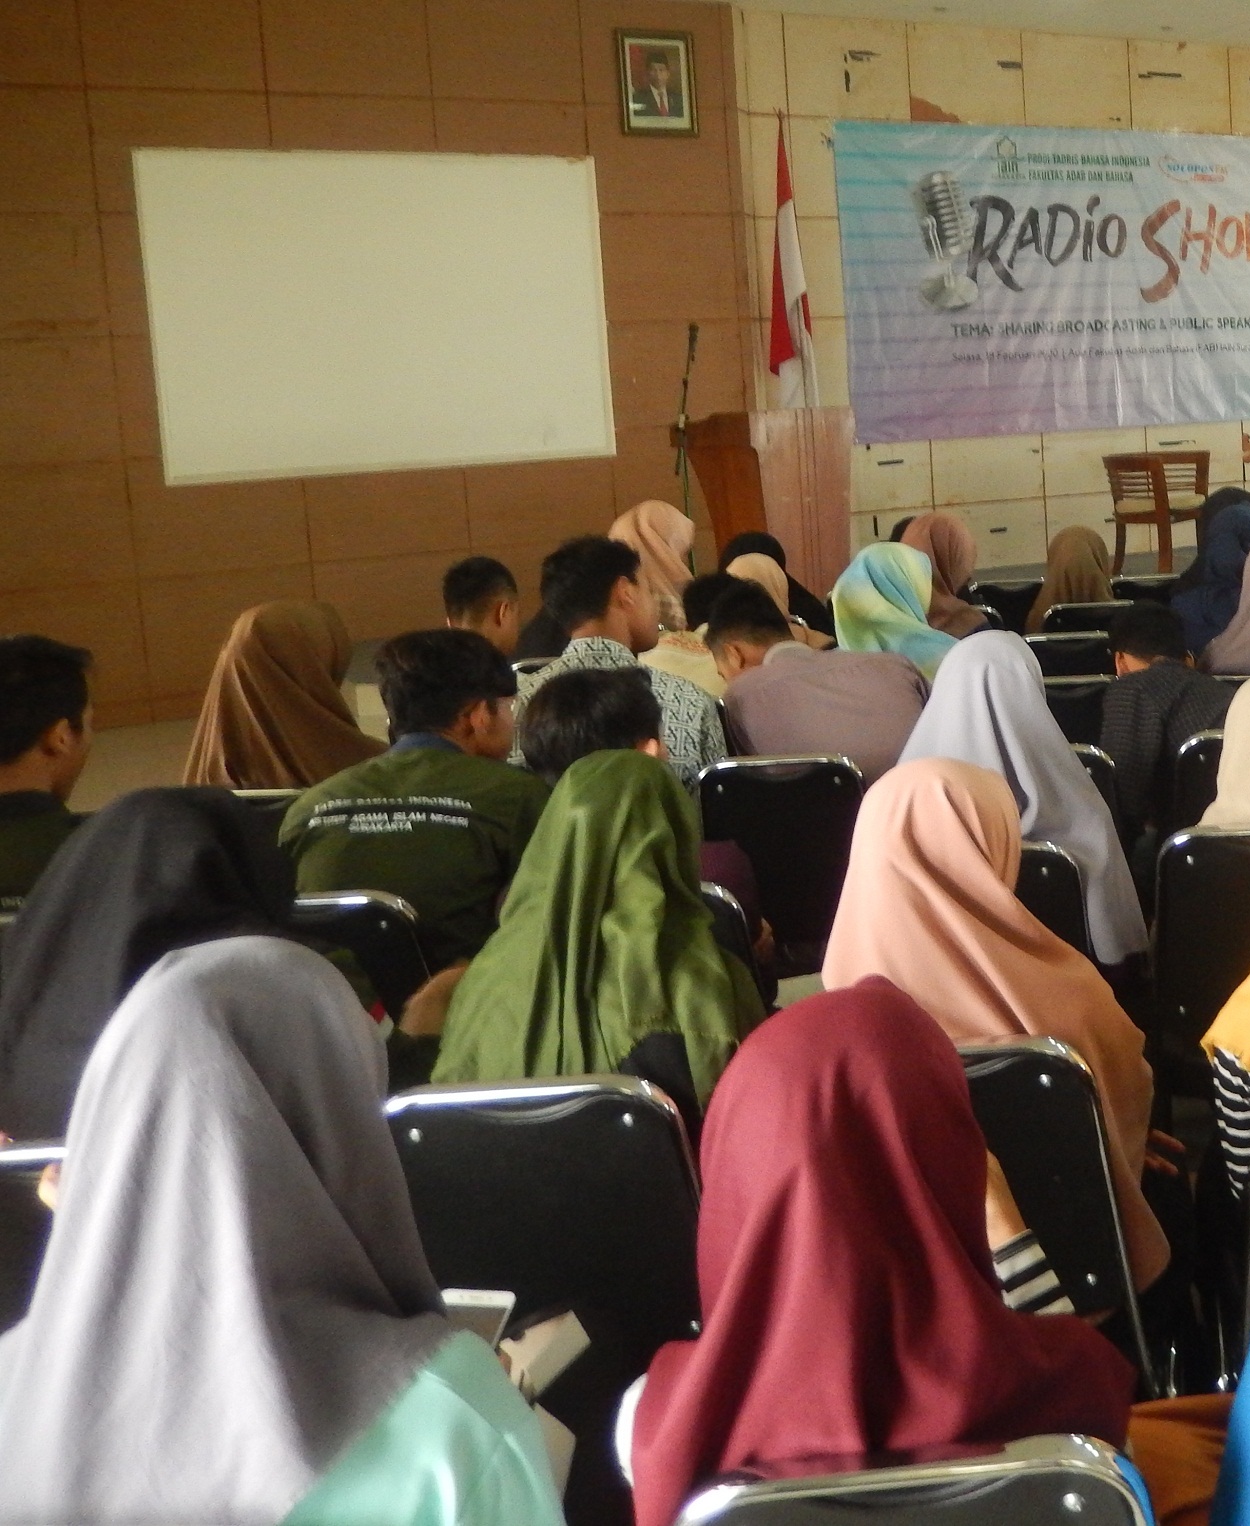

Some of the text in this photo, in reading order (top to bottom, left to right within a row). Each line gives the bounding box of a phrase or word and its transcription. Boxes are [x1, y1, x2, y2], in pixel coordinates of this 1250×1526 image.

[1052, 153, 1079, 166] TADRIS
[1081, 154, 1110, 167] BAHASA
[1111, 154, 1151, 168] INDONESIA
[1028, 169, 1065, 181] FAKULTAS
[1066, 170, 1086, 181] ADAB
[1088, 170, 1103, 182] DAN
[1105, 171, 1134, 183] BAHASA
[1057, 317, 1156, 334] BROADCASTING
[1170, 316, 1214, 330] PUBLIC
[408, 795, 473, 811] INDONESIA
[350, 811, 390, 823] AGAMA
[393, 811, 427, 823] ISLAM
[429, 812, 469, 829] NEGERI
